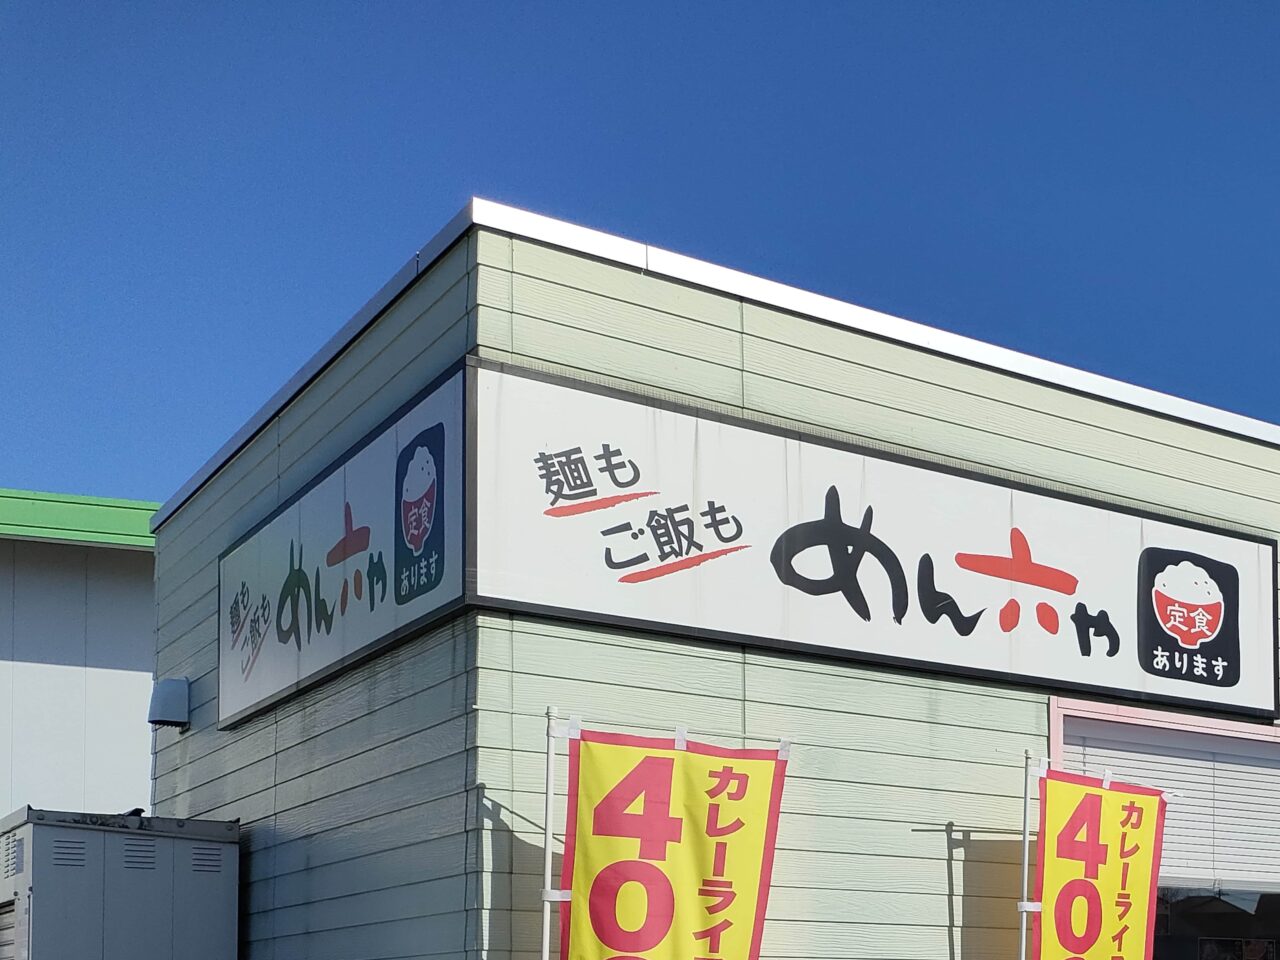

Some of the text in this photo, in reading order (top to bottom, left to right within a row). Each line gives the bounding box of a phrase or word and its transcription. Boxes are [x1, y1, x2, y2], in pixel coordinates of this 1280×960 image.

[533, 443, 641, 506] 麺も
[406, 498, 431, 541] 定食
[601, 501, 744, 571] ご飯も
[276, 501, 388, 652] めん六や
[400, 551, 440, 596] あります
[769, 485, 1120, 658] めん六や
[229, 580, 250, 635] 麺も
[241, 593, 272, 675] ご飯も
[1164, 599, 1215, 636] 定食
[1152, 648, 1229, 682] あります
